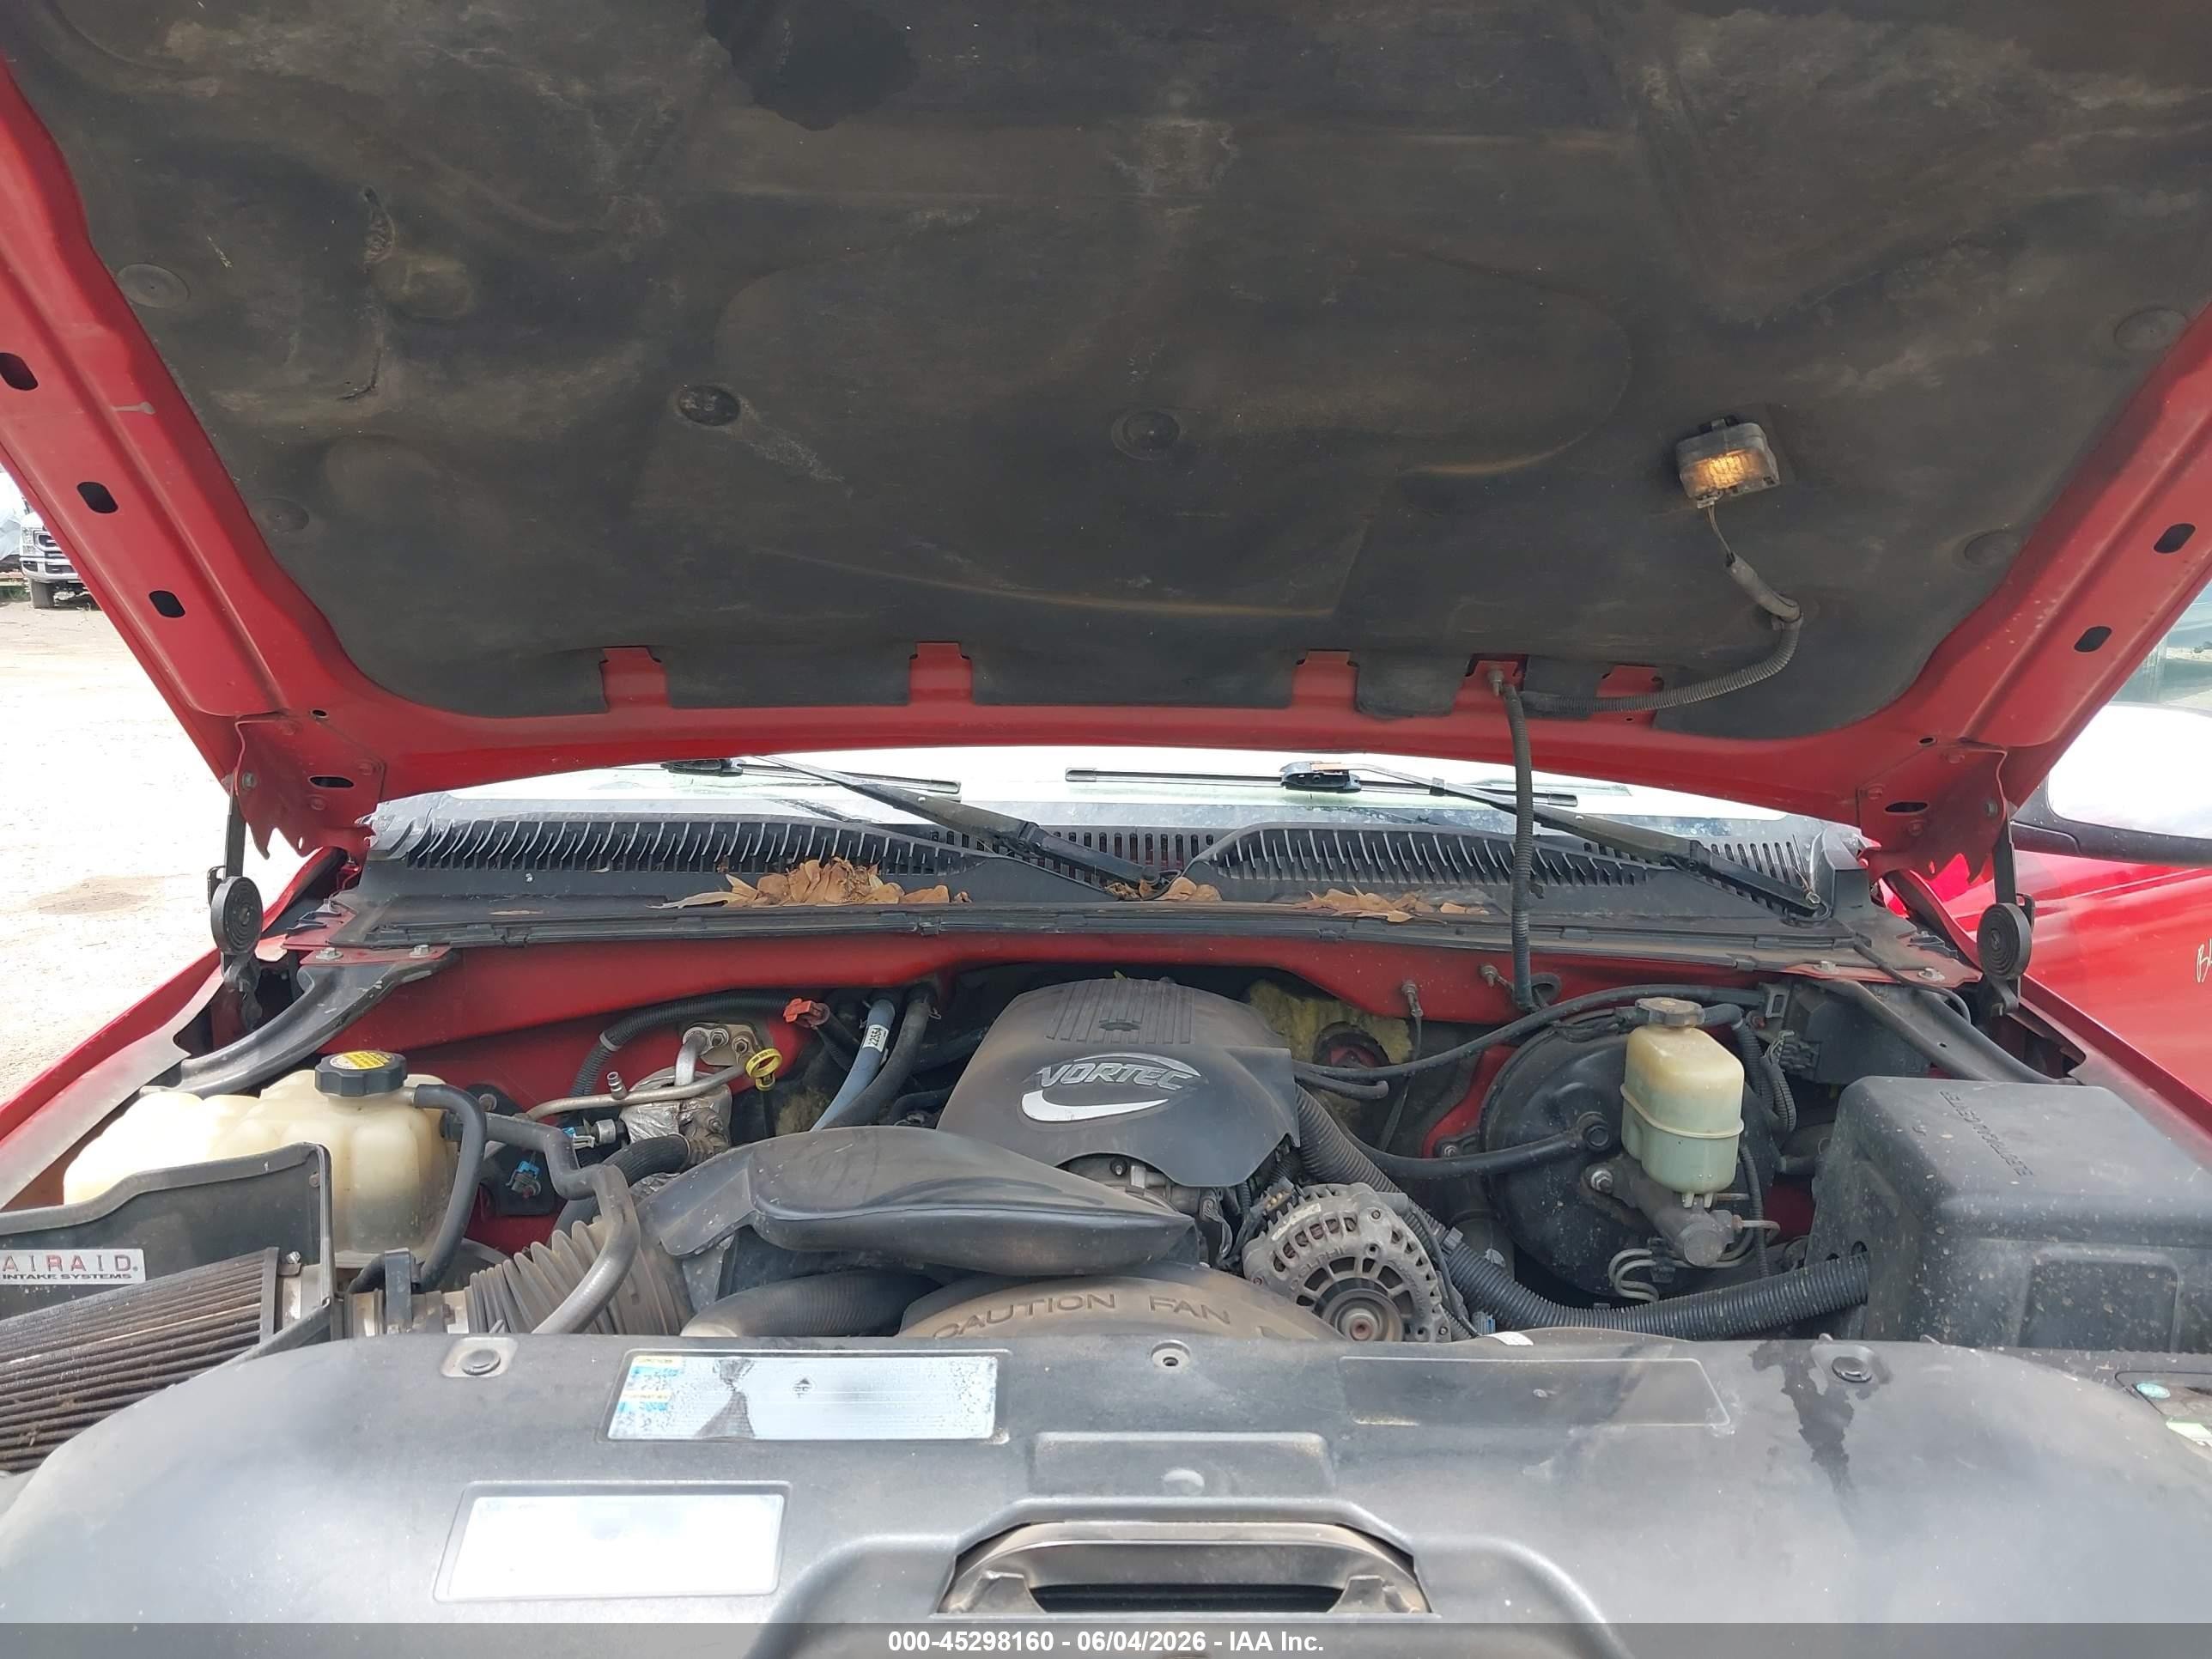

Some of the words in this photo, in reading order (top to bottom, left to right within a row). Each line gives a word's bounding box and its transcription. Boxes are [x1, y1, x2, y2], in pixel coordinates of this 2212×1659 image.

[1036, 1062, 1194, 1091] VORTEC
[2, 1255, 131, 1272] AIRAID
[932, 1293, 1115, 1338] CAUTION
[1149, 1295, 1231, 1324] FAN
